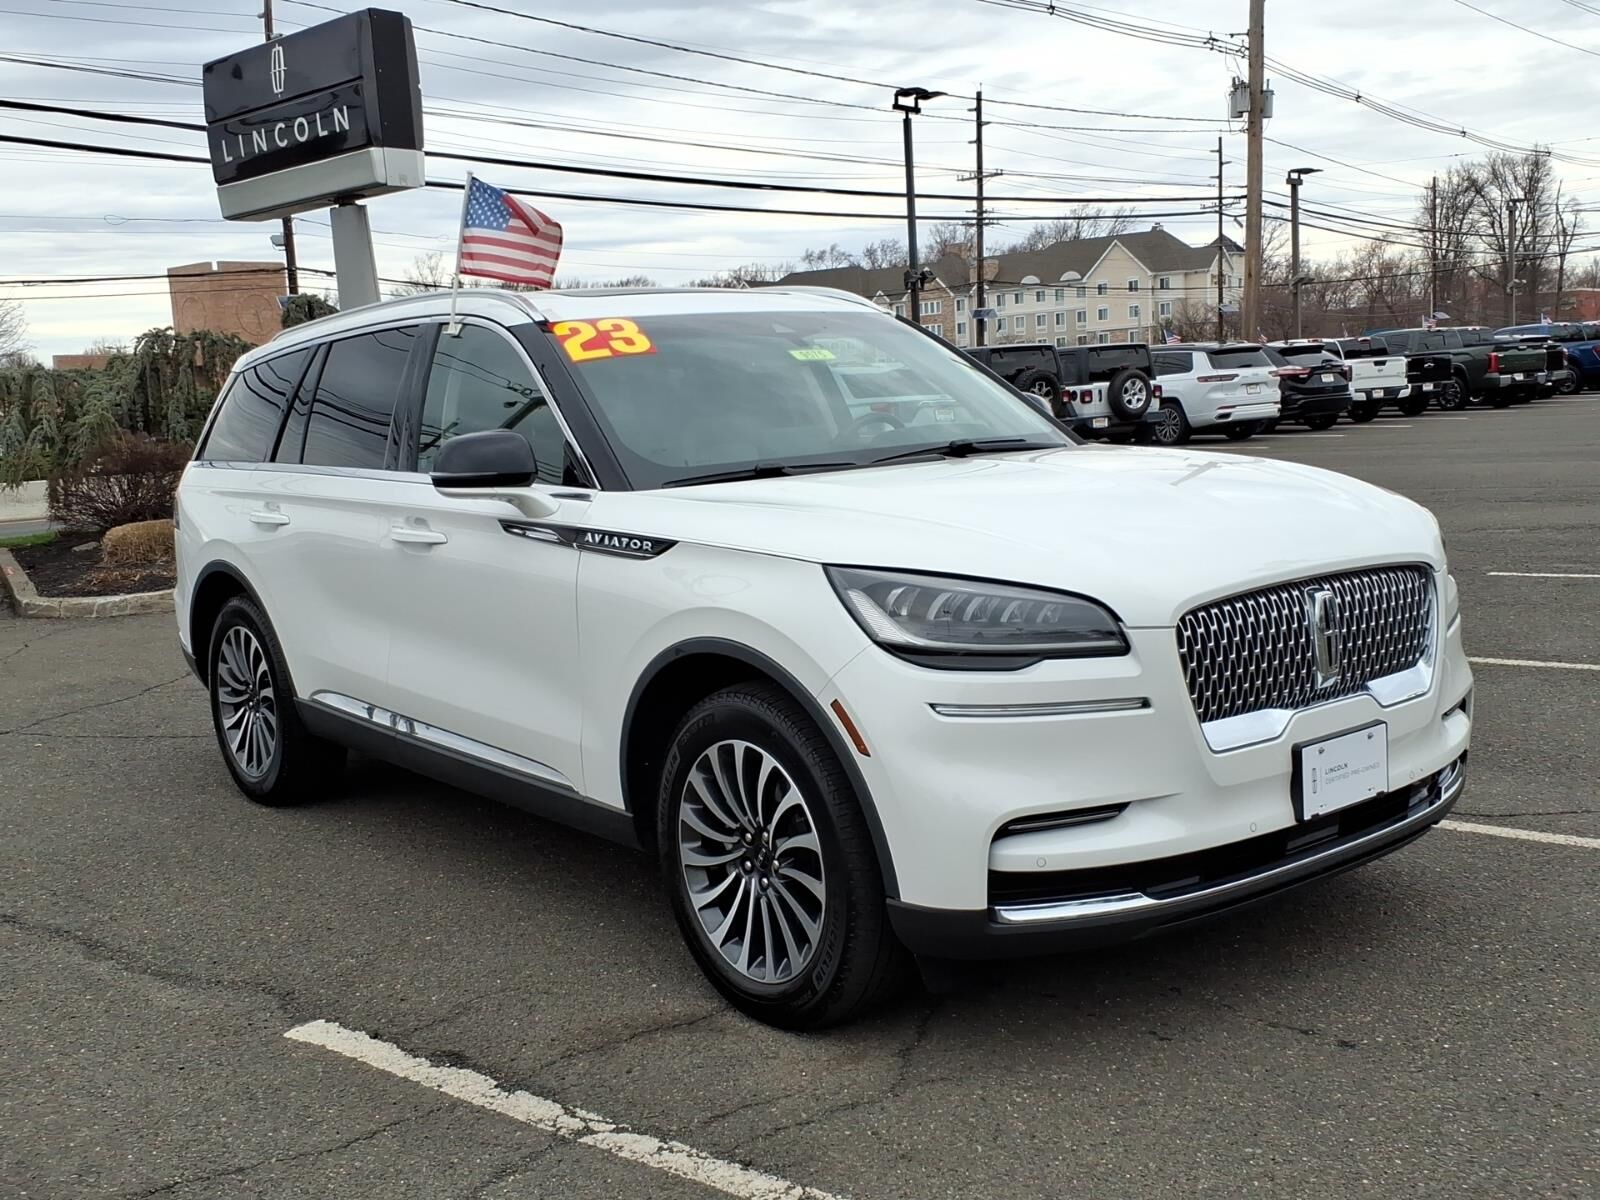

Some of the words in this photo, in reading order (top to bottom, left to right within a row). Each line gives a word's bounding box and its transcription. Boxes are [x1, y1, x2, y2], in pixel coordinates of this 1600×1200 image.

[222, 105, 350, 162] LINCOLN
[552, 317, 653, 361] 23
[584, 532, 653, 552] AVIATOR
[1325, 763, 1348, 775] LINCOLN
